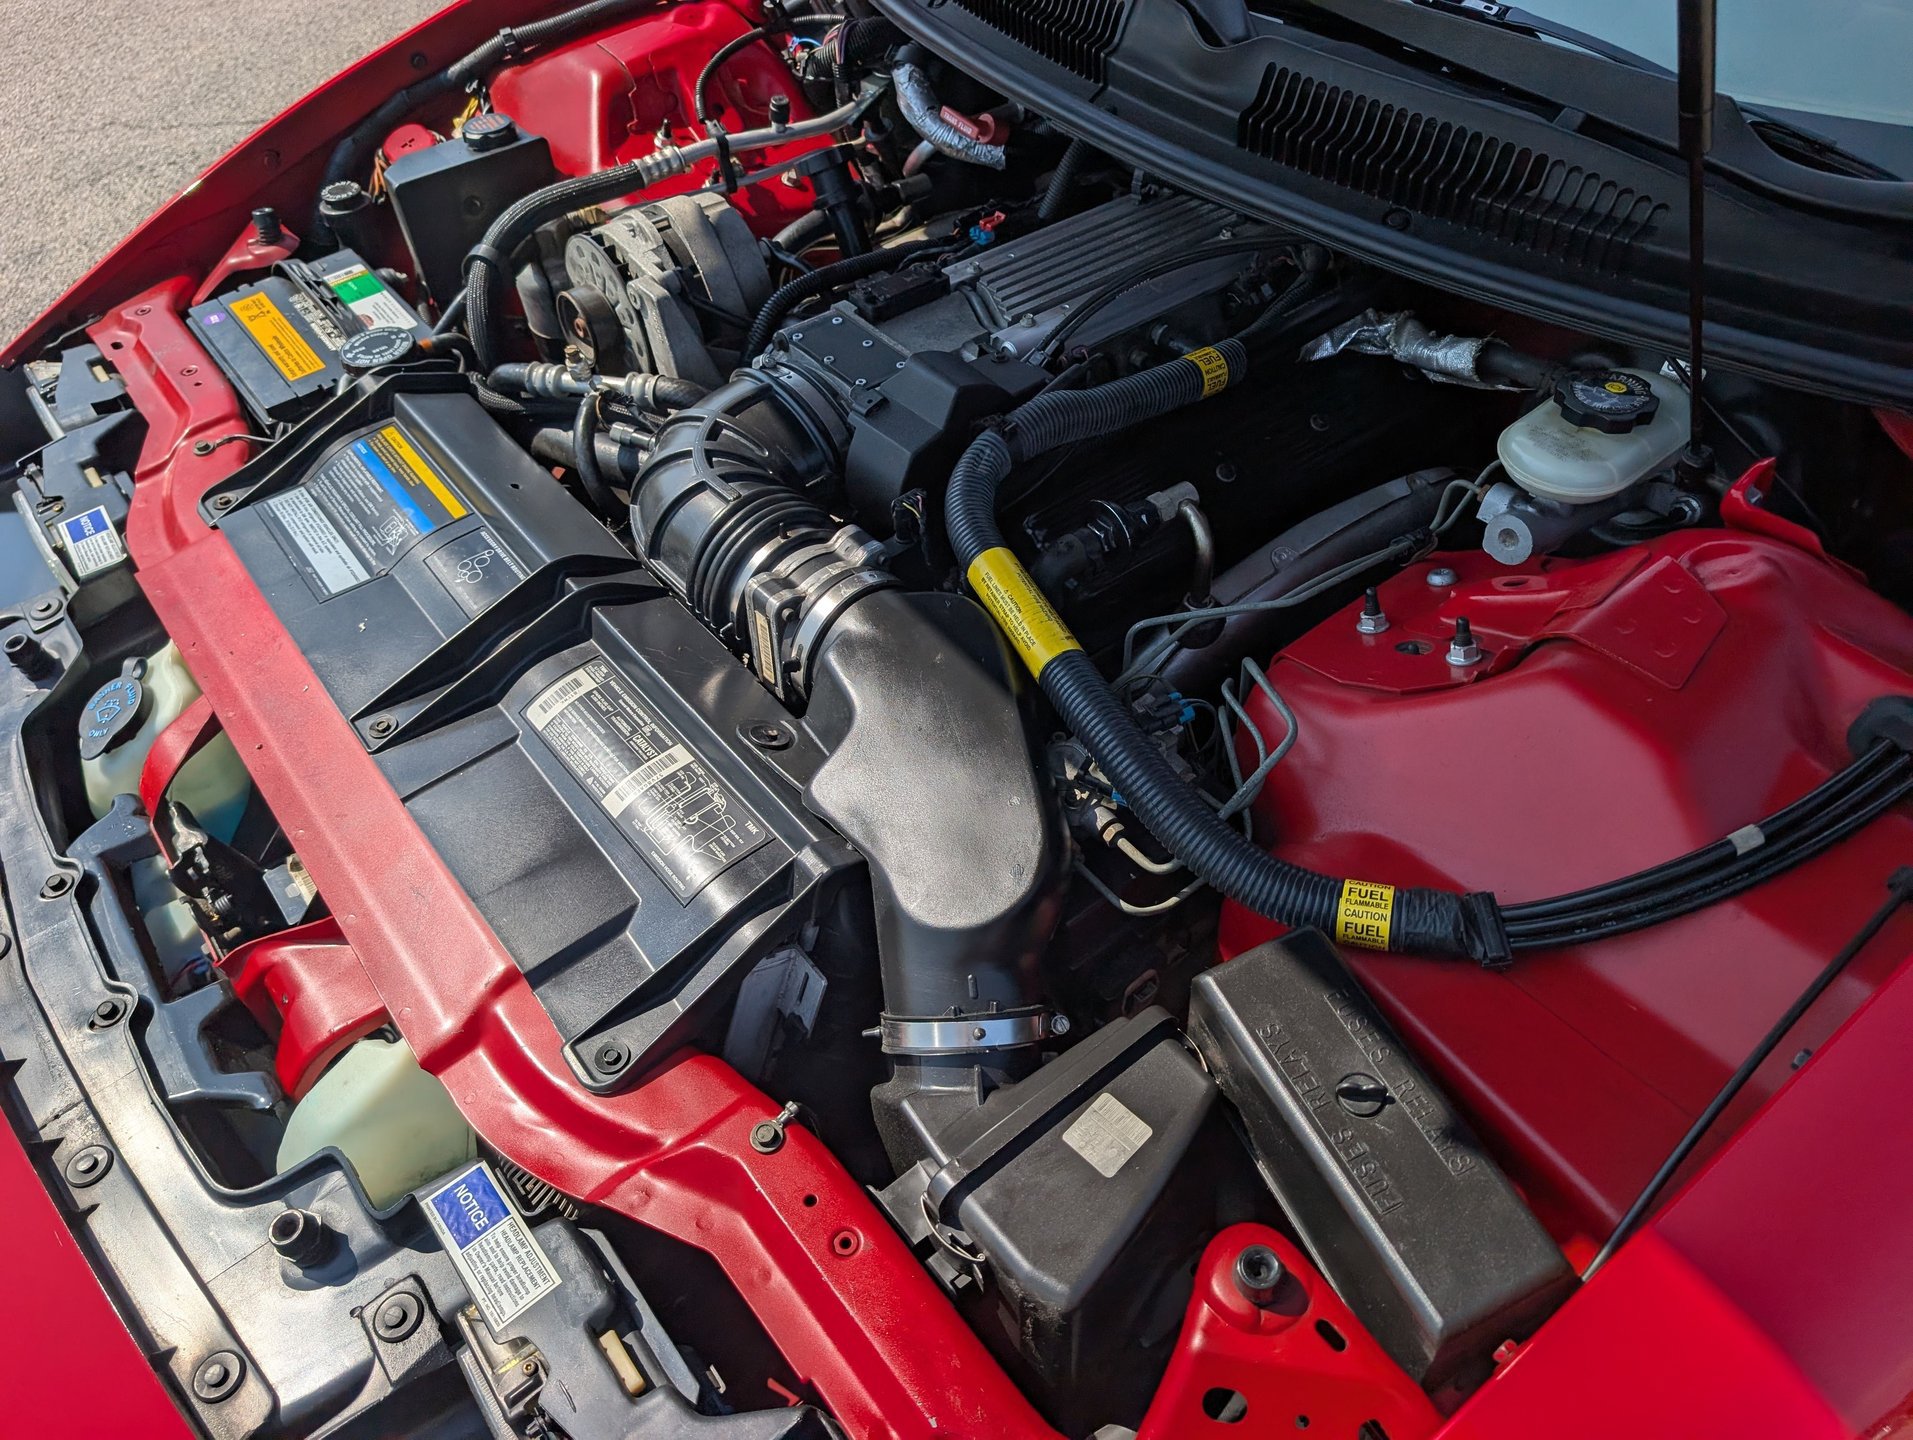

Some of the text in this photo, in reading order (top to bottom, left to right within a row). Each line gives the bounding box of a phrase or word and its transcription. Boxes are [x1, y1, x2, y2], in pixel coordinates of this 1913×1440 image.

[1199, 354, 1222, 366] FUEL
[79, 515, 96, 537] NOTICE
[984, 572, 994, 584] FUEL
[991, 583, 1003, 596] LINES
[1000, 595, 1010, 608] MUST
[1008, 607, 1015, 615] BE
[1012, 613, 1023, 627] HELD
[1023, 630, 1037, 647] PLACE
[1007, 594, 1023, 614] CAUTION
[89, 681, 134, 711] WASHER FLUID
[89, 728, 109, 737] ONLY
[632, 734, 658, 759] CATALYST
[745, 821, 759, 835] TMK
[1348, 887, 1389, 902] FUEL
[1349, 881, 1391, 890] CAUTION
[1345, 898, 1389, 910] FLAMMABLE
[1344, 908, 1387, 922] CAUTION
[1342, 934, 1385, 945] FLAMMABLE
[1344, 922, 1386, 938] FUEL
[1325, 986, 1474, 1175] FUSES RELAYS
[1258, 1020, 1400, 1212] FUSES RELAYS
[452, 1183, 490, 1232] NOTICE
[499, 1229, 541, 1290] HEADLAMP REPLACEMENT
[506, 1221, 550, 1285] HEADLAMP ADJUSTMENT
